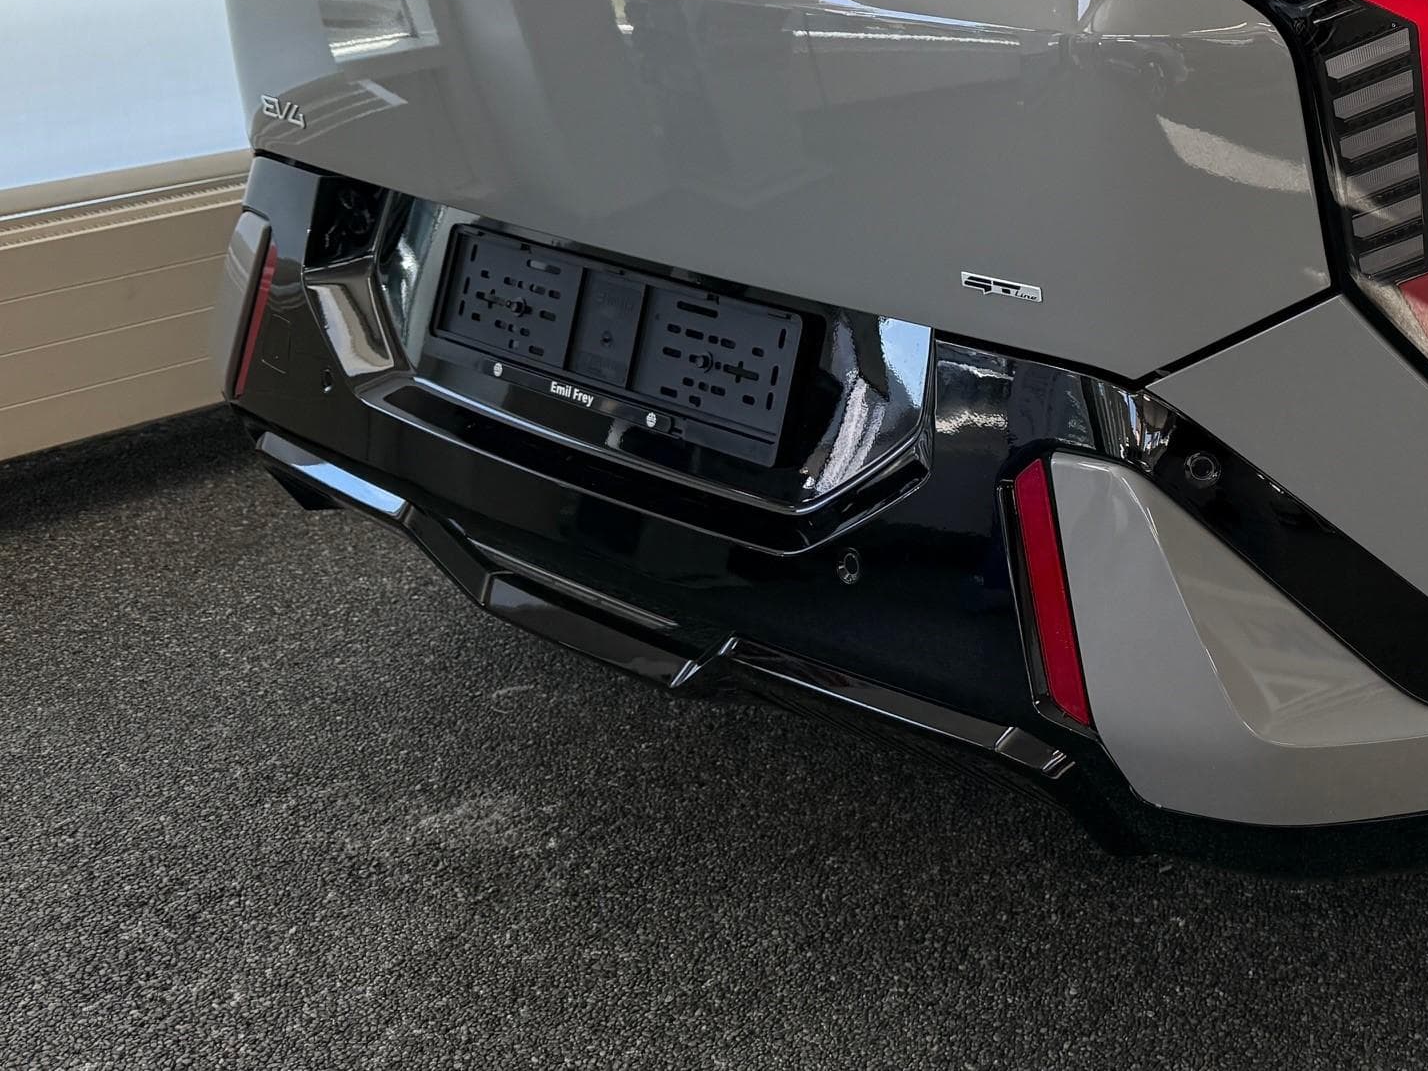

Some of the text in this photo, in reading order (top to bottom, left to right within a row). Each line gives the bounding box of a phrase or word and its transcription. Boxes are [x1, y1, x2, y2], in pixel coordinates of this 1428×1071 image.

[261, 94, 306, 129] EV4
[551, 381, 594, 407] Emil Frey
